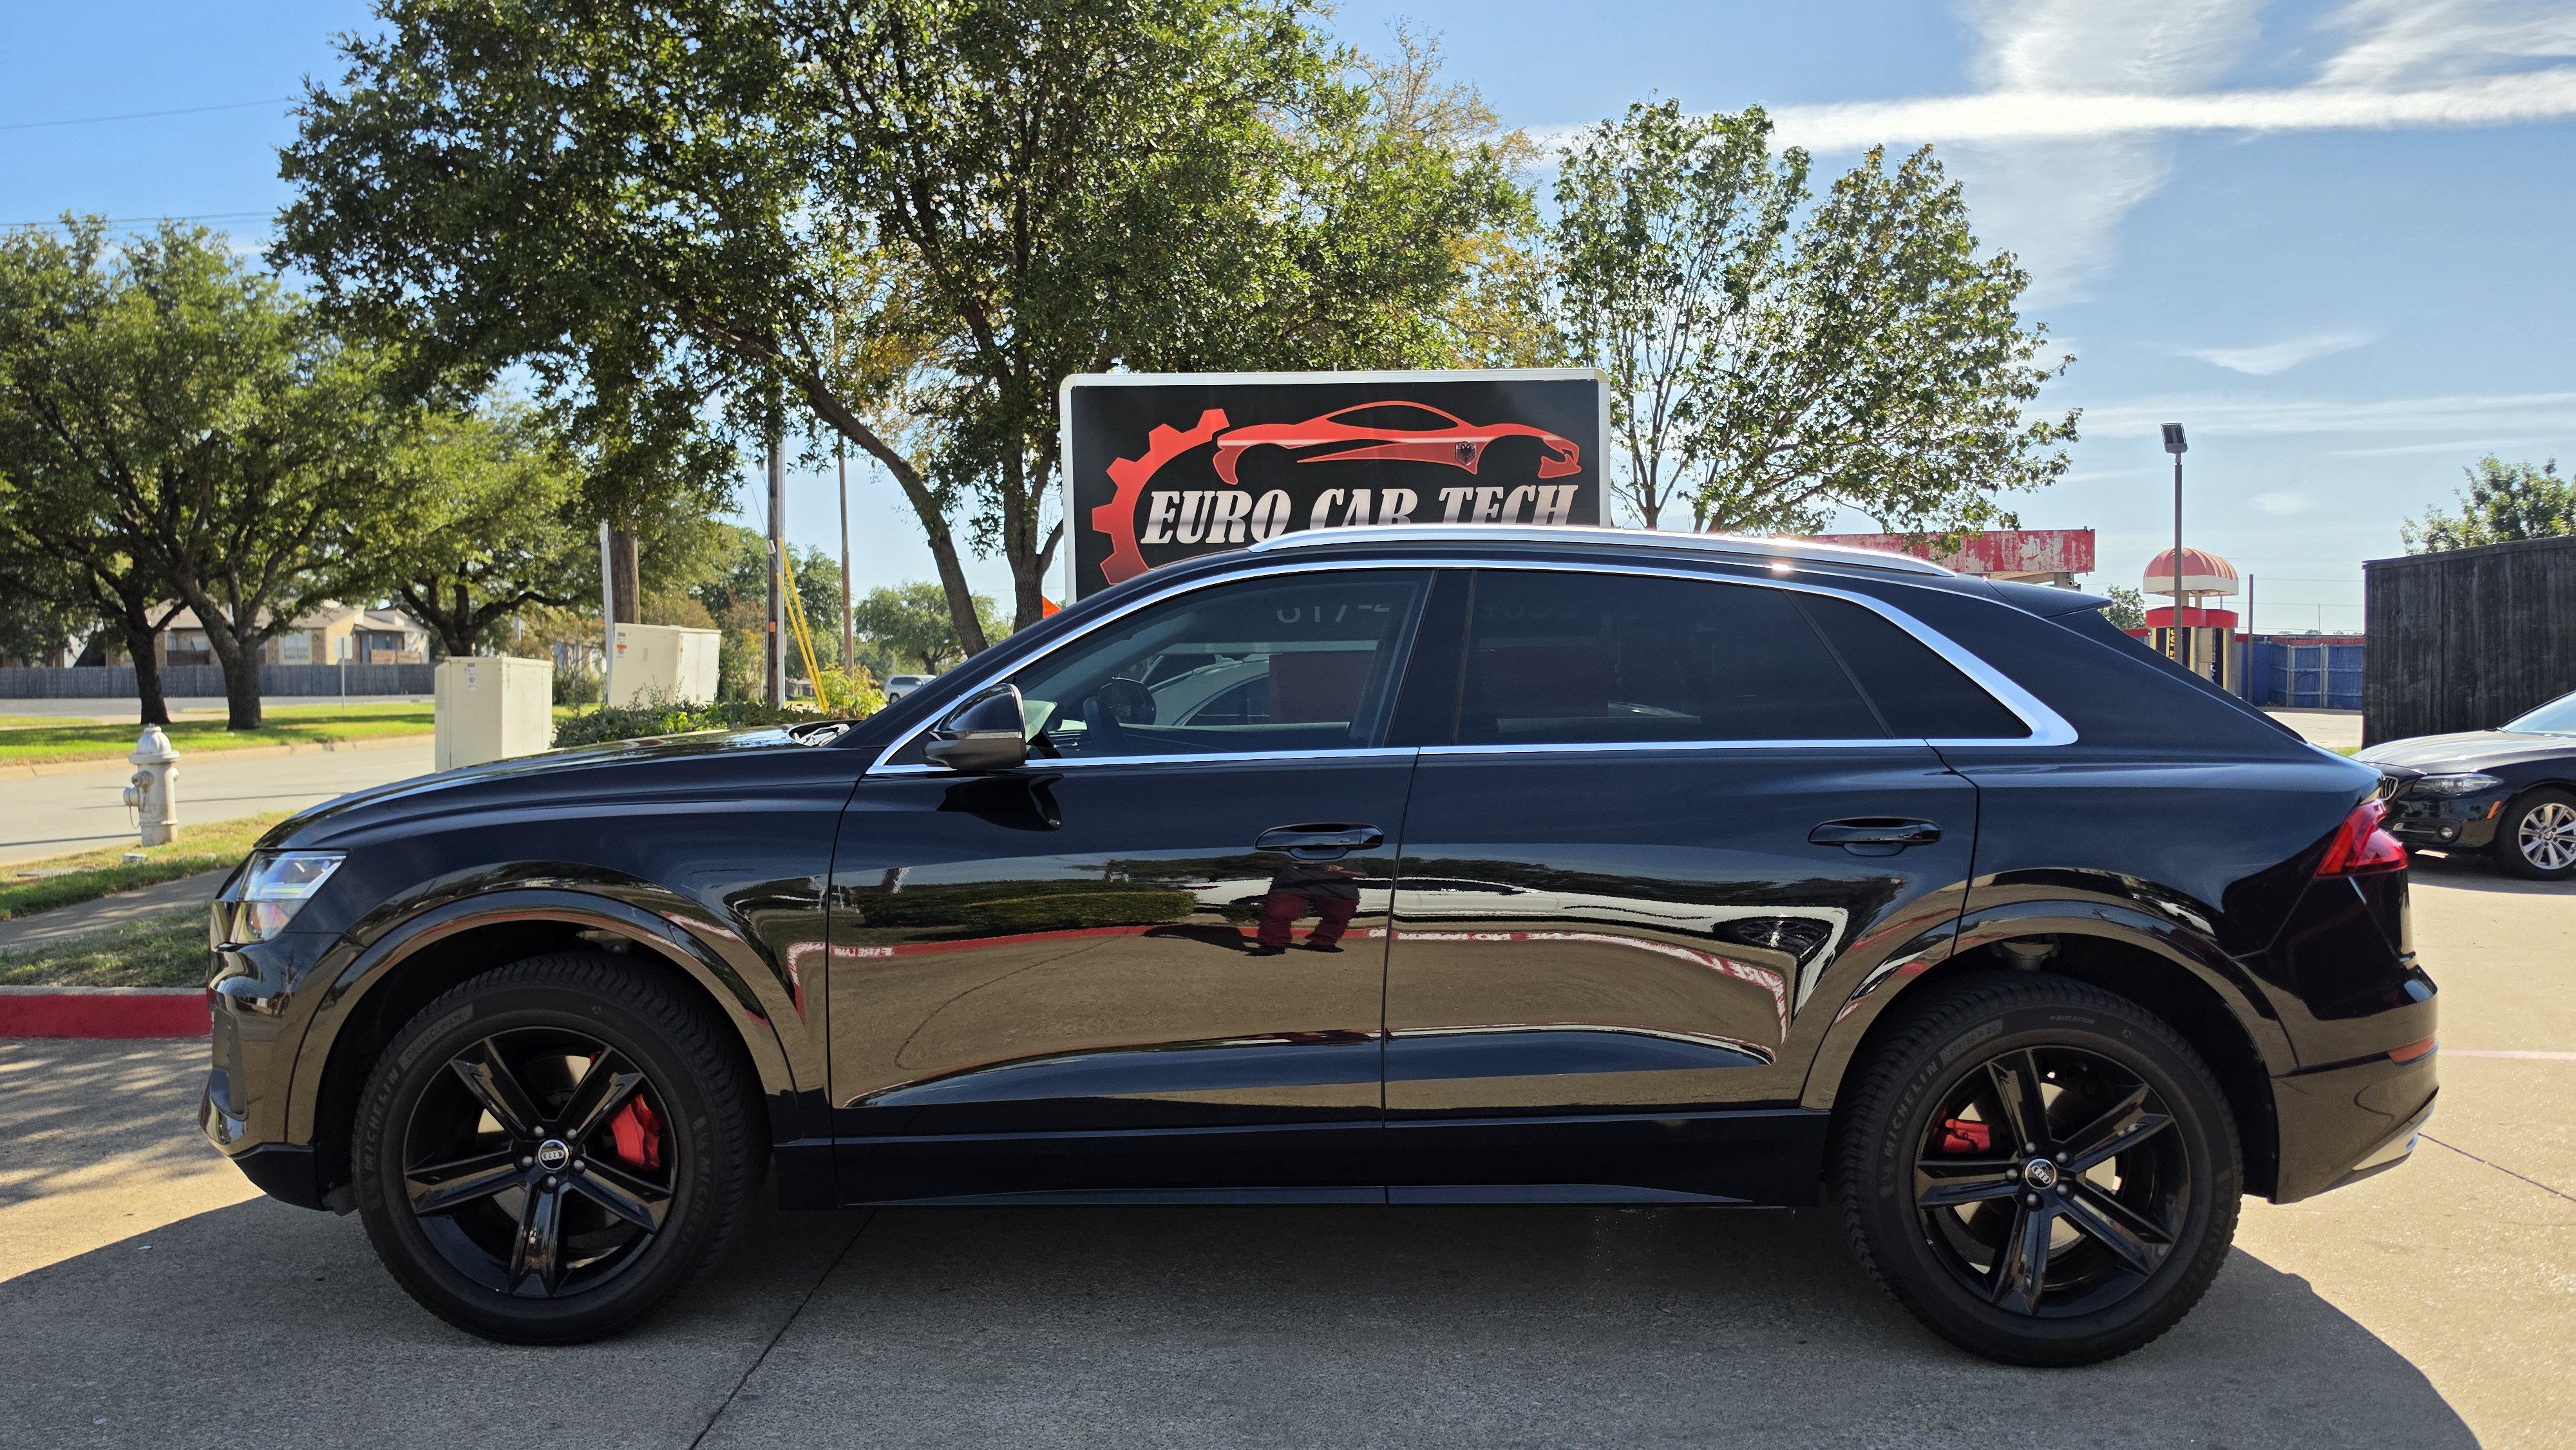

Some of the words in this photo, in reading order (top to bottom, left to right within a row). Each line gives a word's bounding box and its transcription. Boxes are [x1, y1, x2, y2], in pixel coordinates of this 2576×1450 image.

[1140, 489, 1291, 544] EURO
[1309, 488, 1418, 531] CAR
[1438, 485, 1579, 525] TECH
[365, 1068, 400, 1172] MICHELIN
[1884, 1060, 1938, 1159] MICHELIN
